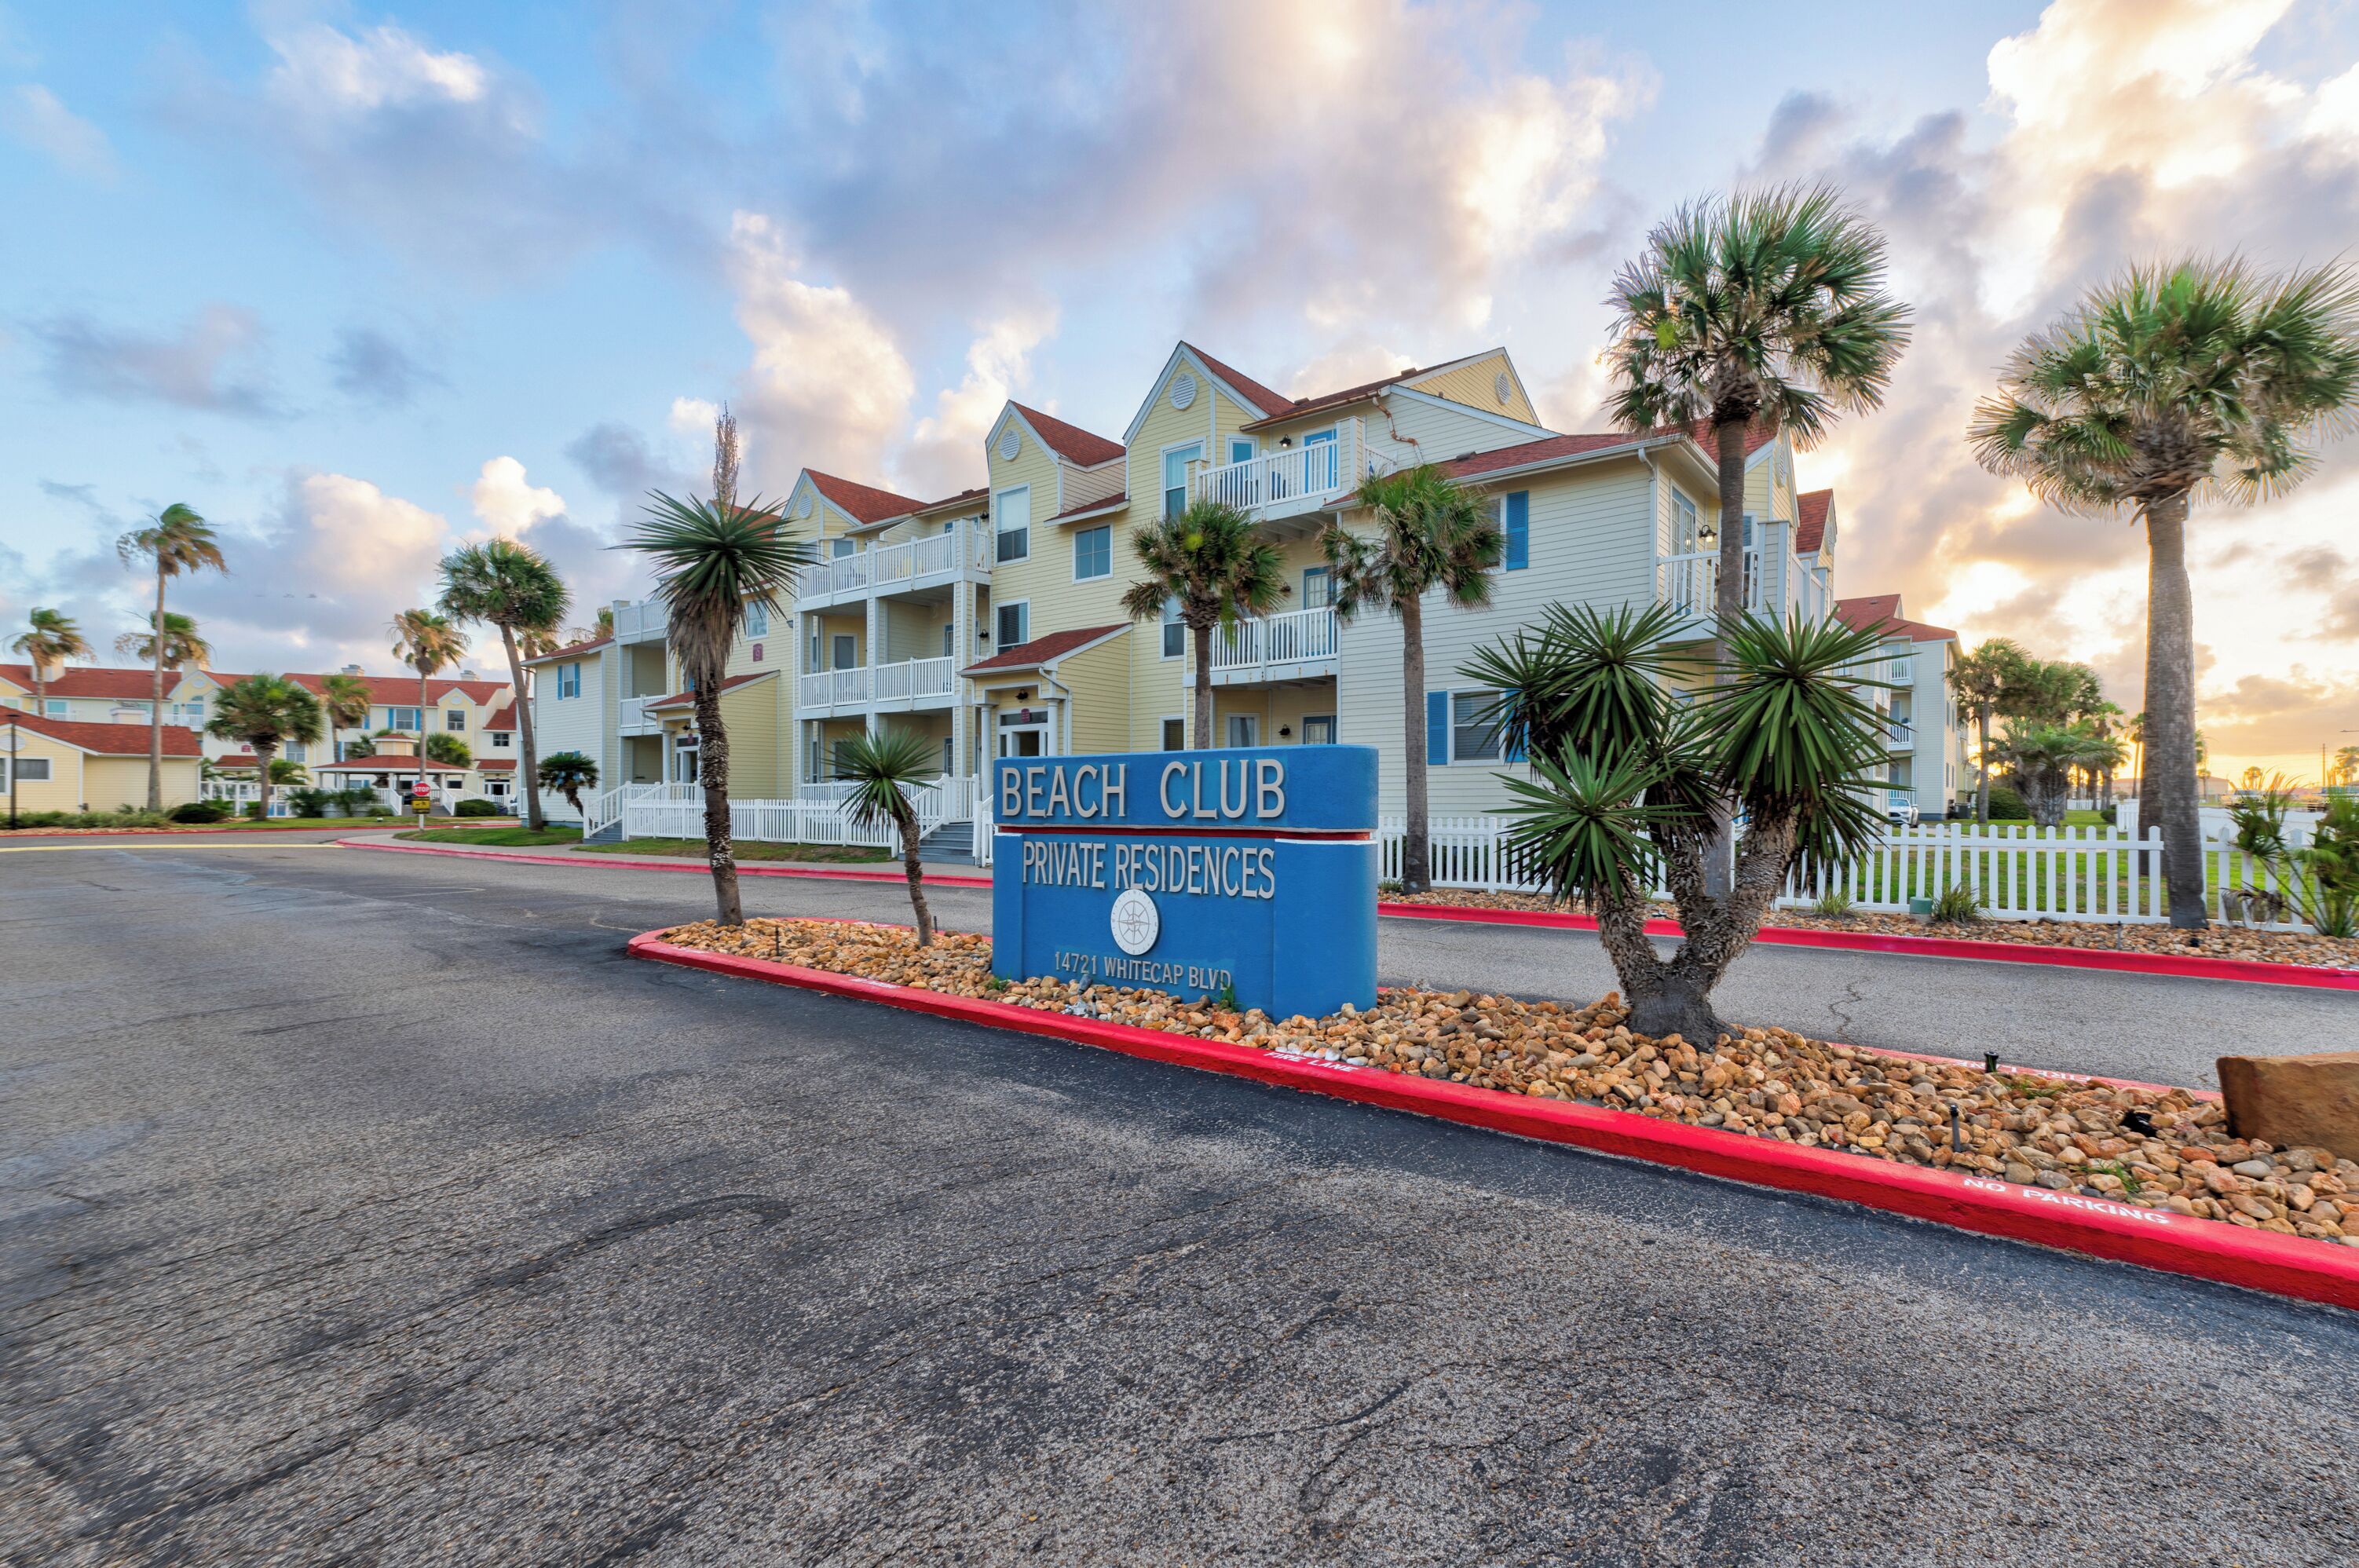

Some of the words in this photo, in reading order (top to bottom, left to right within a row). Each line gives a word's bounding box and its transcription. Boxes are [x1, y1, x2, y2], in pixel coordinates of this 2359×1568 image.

[1001, 763, 1126, 818] BEACH
[1160, 759, 1286, 819] CLUB
[1022, 841, 1106, 889] PRIVATE
[1115, 843, 1275, 899] RESIDENCES
[1055, 952, 1097, 974] 14721
[1103, 956, 1183, 985] WHITECAP
[1188, 966, 1231, 990] BLVD
[1263, 1051, 1307, 1062] FIRE
[1307, 1059, 1359, 1072] LANE
[1963, 1178, 2006, 1193] NO
[2022, 1188, 2170, 1225] PARKING
